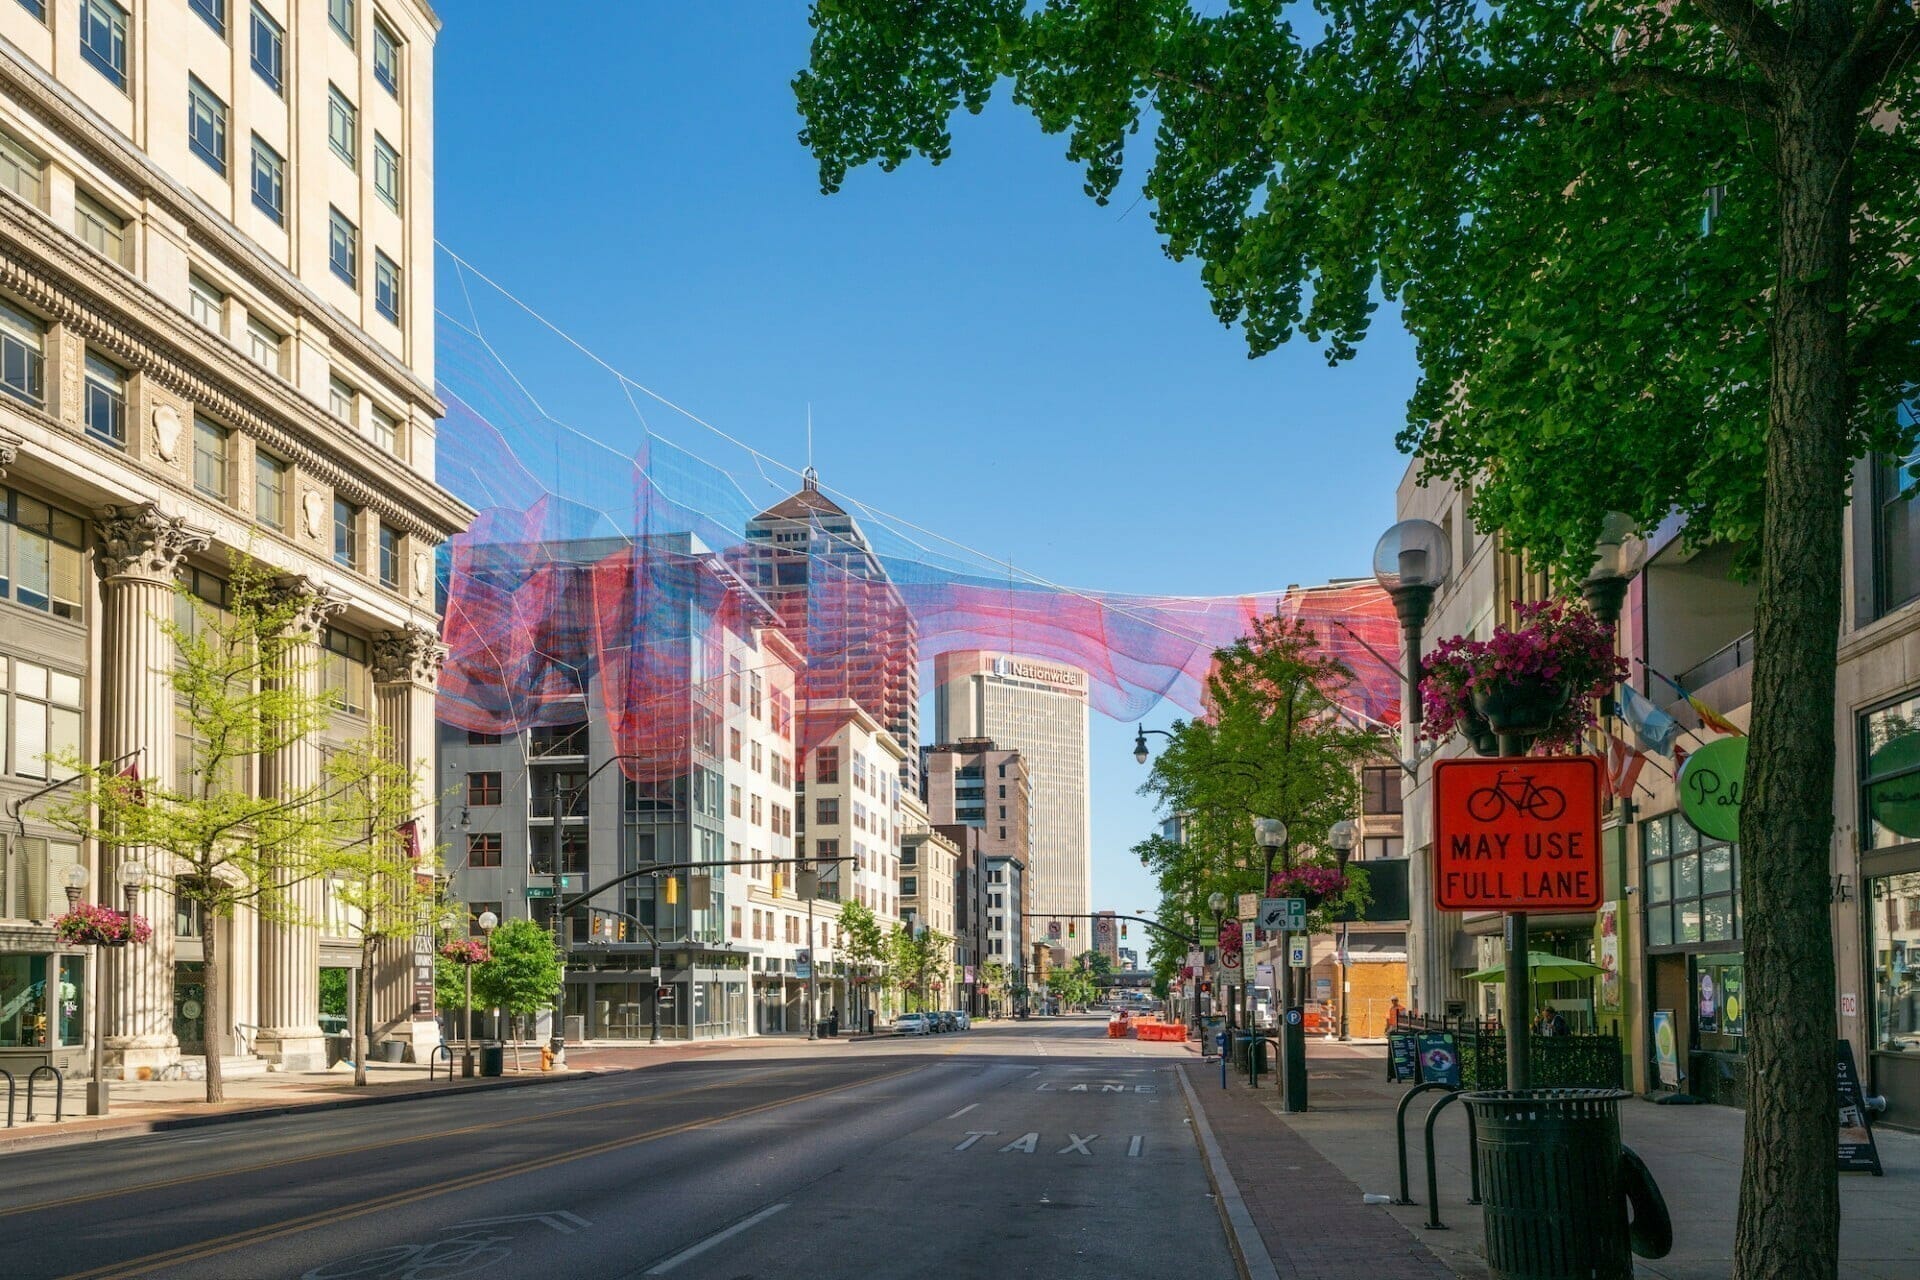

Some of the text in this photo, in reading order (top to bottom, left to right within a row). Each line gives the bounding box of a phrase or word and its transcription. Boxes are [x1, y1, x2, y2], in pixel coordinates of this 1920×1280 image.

[1012, 662, 1077, 686] Nationwide
[1451, 831, 1584, 861] MAY USE
[1446, 871, 1590, 899] FULL LANE
[1290, 902, 1301, 914] P
[1290, 1012, 1298, 1022] P
[1036, 1083, 1158, 1094] LANE
[953, 1130, 1145, 1157] TAXI
